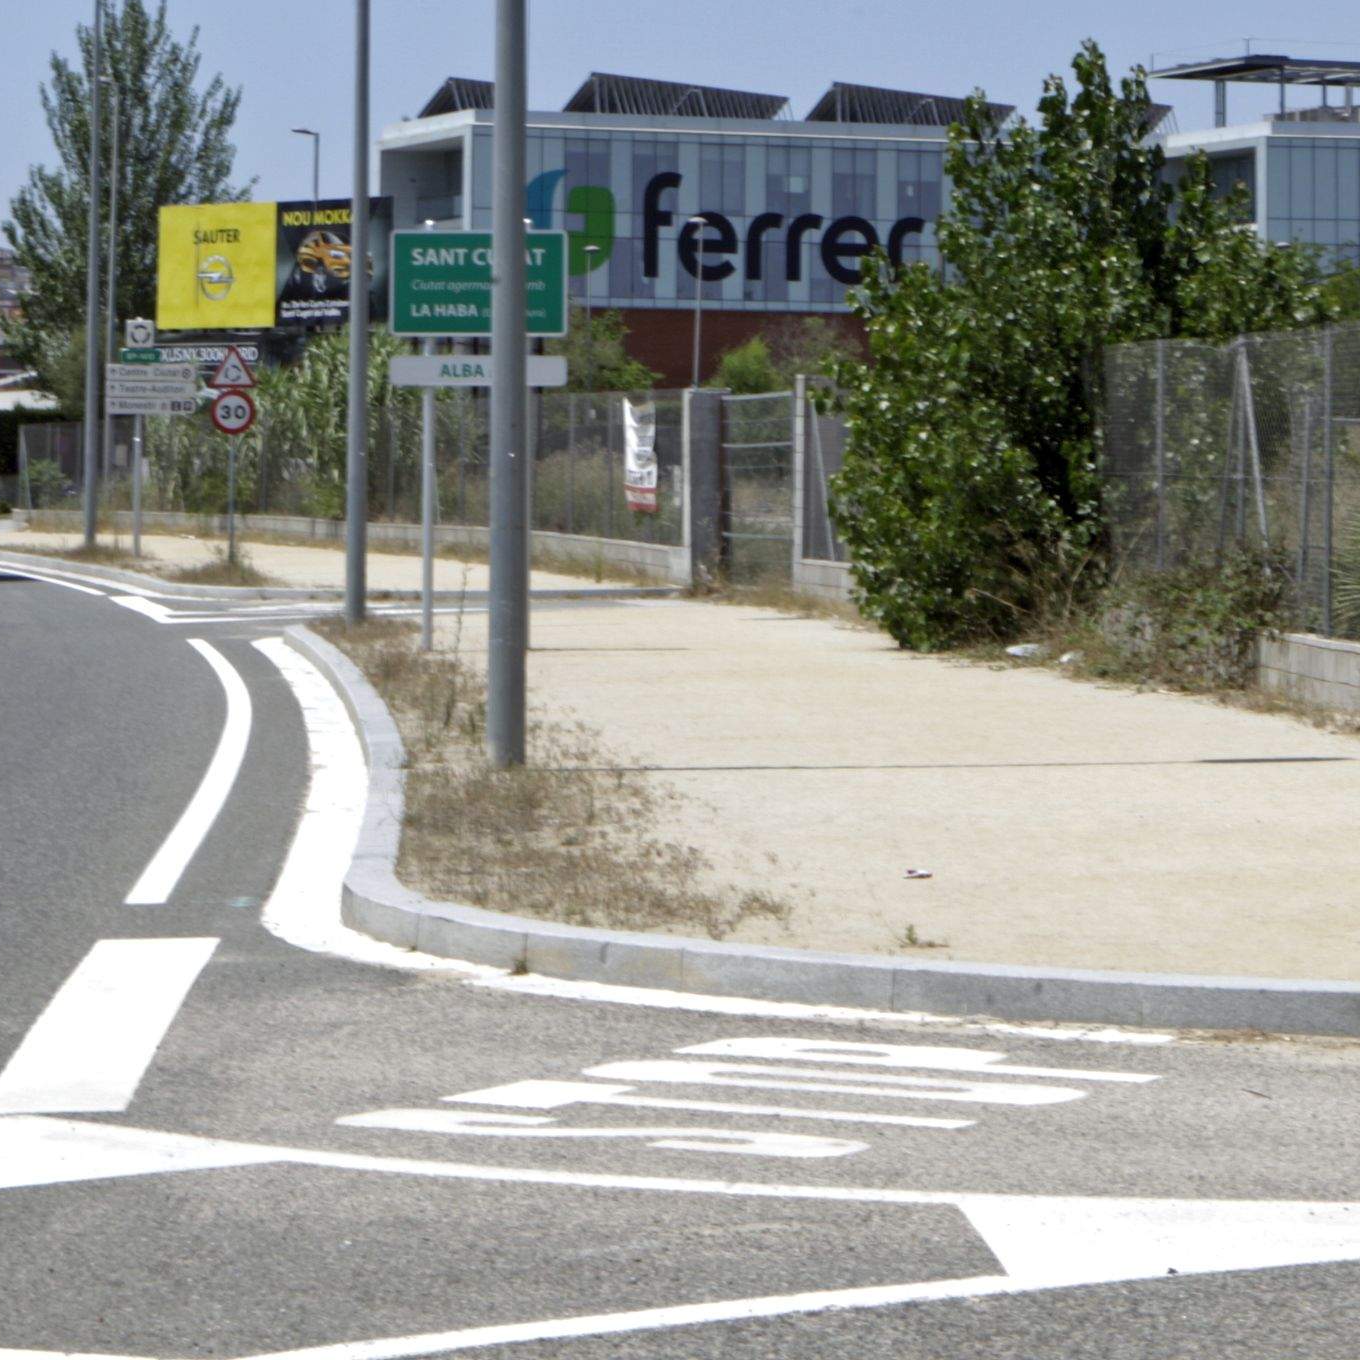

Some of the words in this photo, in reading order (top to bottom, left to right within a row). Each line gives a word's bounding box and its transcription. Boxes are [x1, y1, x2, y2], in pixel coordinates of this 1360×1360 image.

[283, 210, 311, 226] NOU
[313, 209, 353, 225] MOKK
[193, 228, 240, 245] SAUTER
[643, 171, 926, 285] ferrer
[411, 248, 468, 266] SANT
[411, 304, 431, 318] LA
[433, 304, 478, 318] HABA
[441, 364, 485, 378] ALBA
[220, 404, 247, 419] 30
[334, 1036, 1163, 1158] STOP
